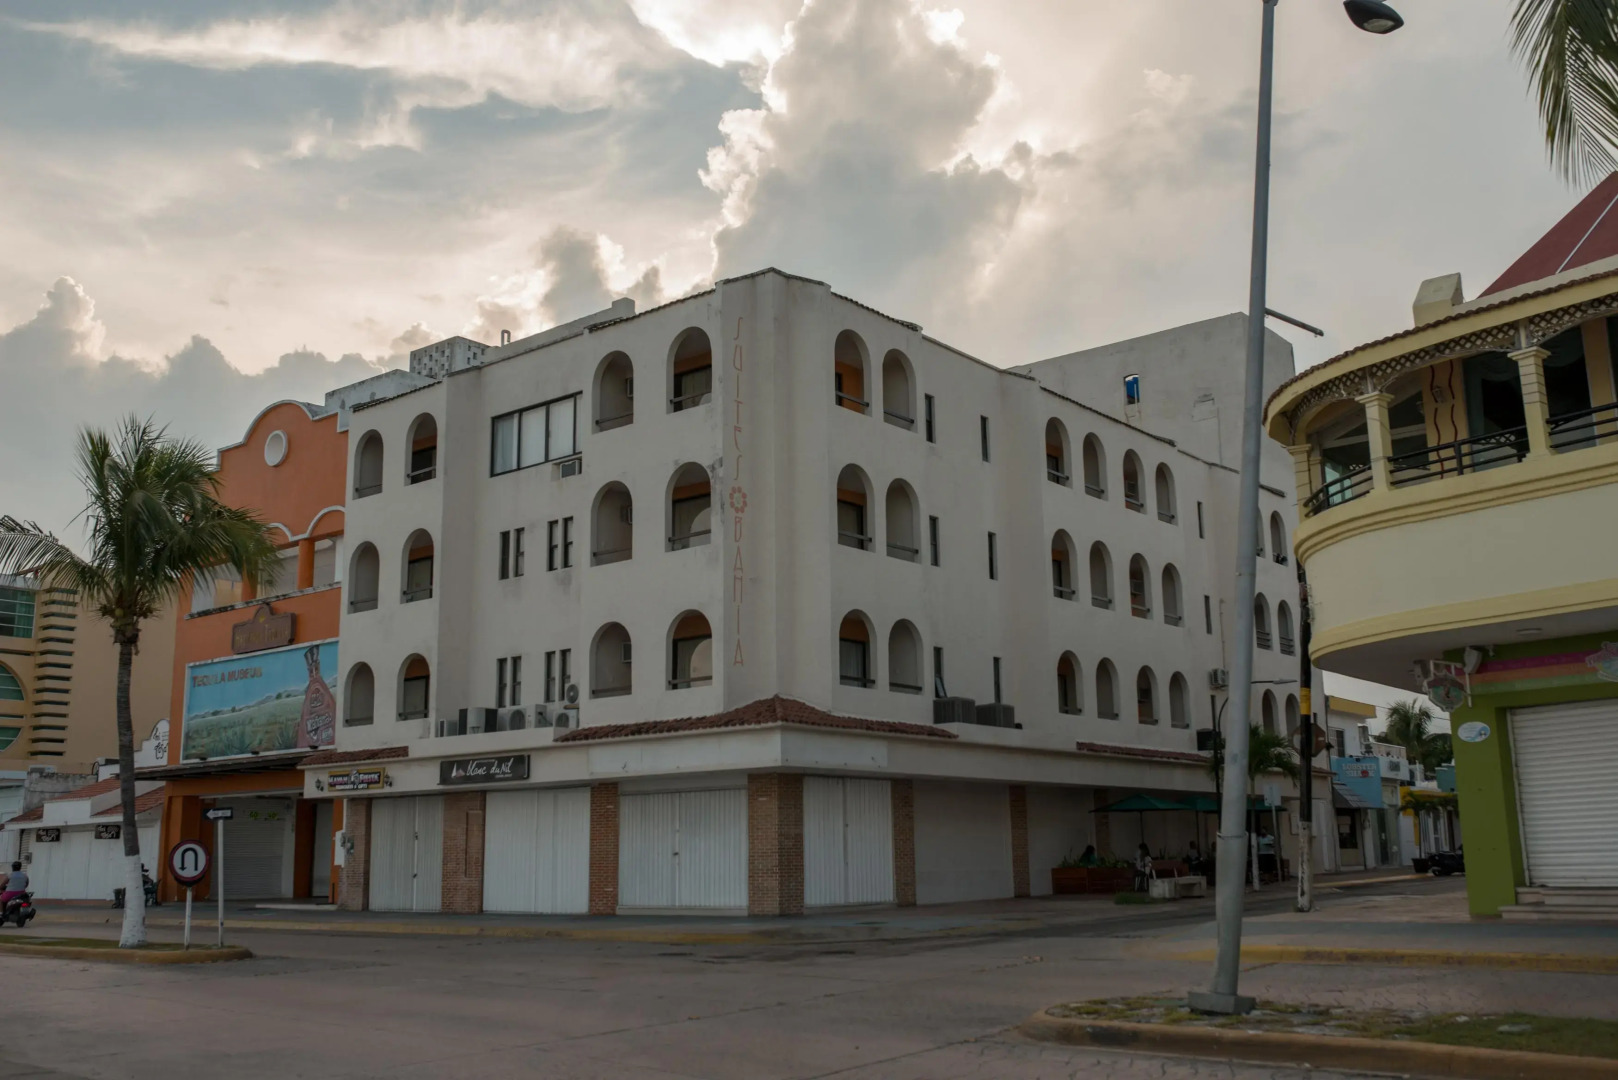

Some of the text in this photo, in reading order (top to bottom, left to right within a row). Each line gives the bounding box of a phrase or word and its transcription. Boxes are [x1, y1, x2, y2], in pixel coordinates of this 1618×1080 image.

[732, 316, 745, 667] SUITES BAHIA
[192, 672, 226, 688] TEQUILA
[1342, 763, 1377, 771] LOBSTER
